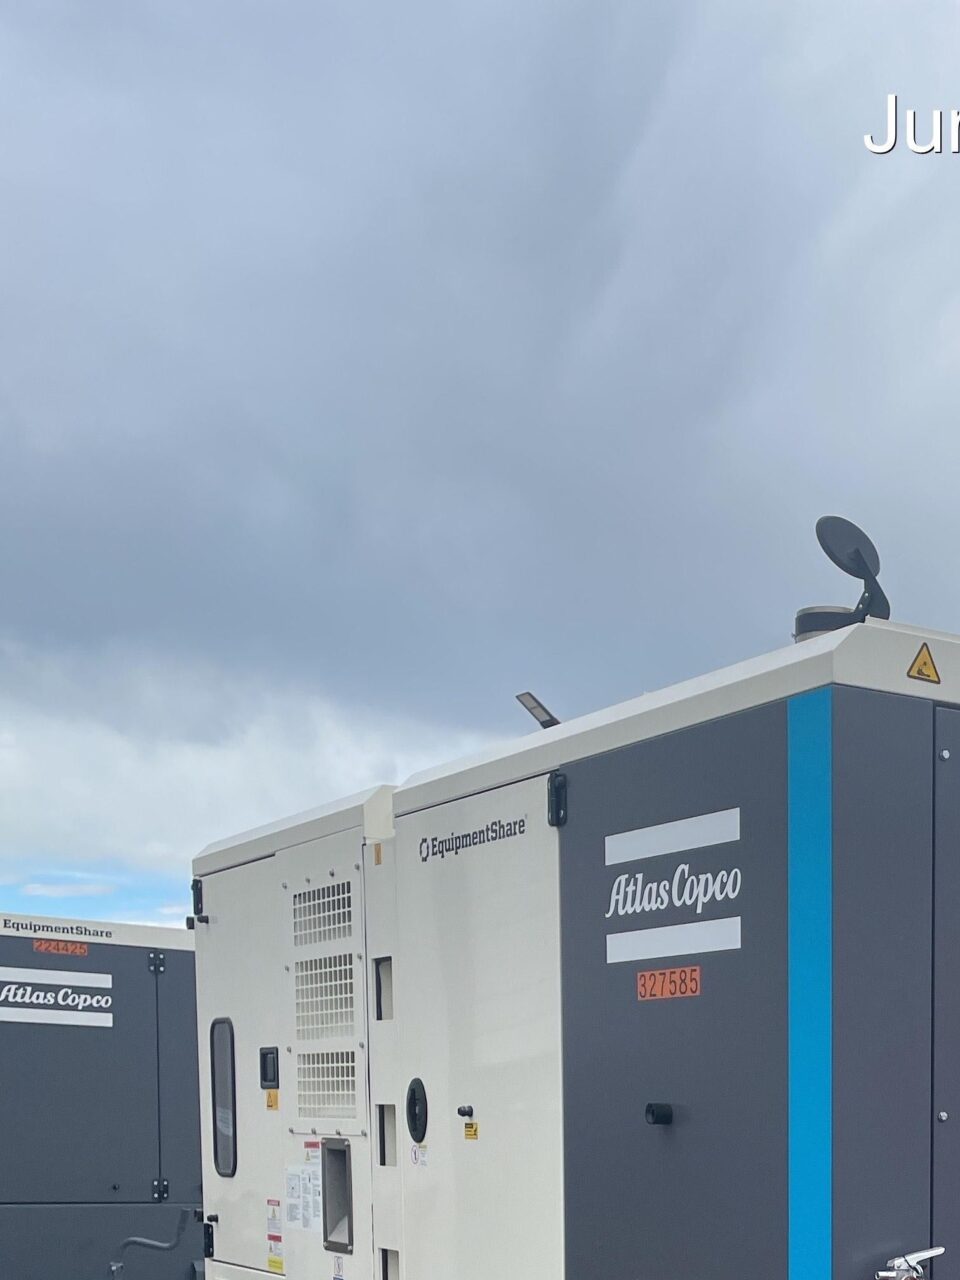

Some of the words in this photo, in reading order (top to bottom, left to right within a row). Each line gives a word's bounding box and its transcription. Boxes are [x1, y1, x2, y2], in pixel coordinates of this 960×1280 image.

[430, 817, 526, 859] EquipmentShare
[605, 872, 670, 918] Atlas
[671, 863, 742, 914] Copco
[3, 919, 113, 938] EquipmentShare
[0, 984, 56, 1005] Atlas
[57, 987, 113, 1011] Copco
[638, 968, 700, 999] 327585
